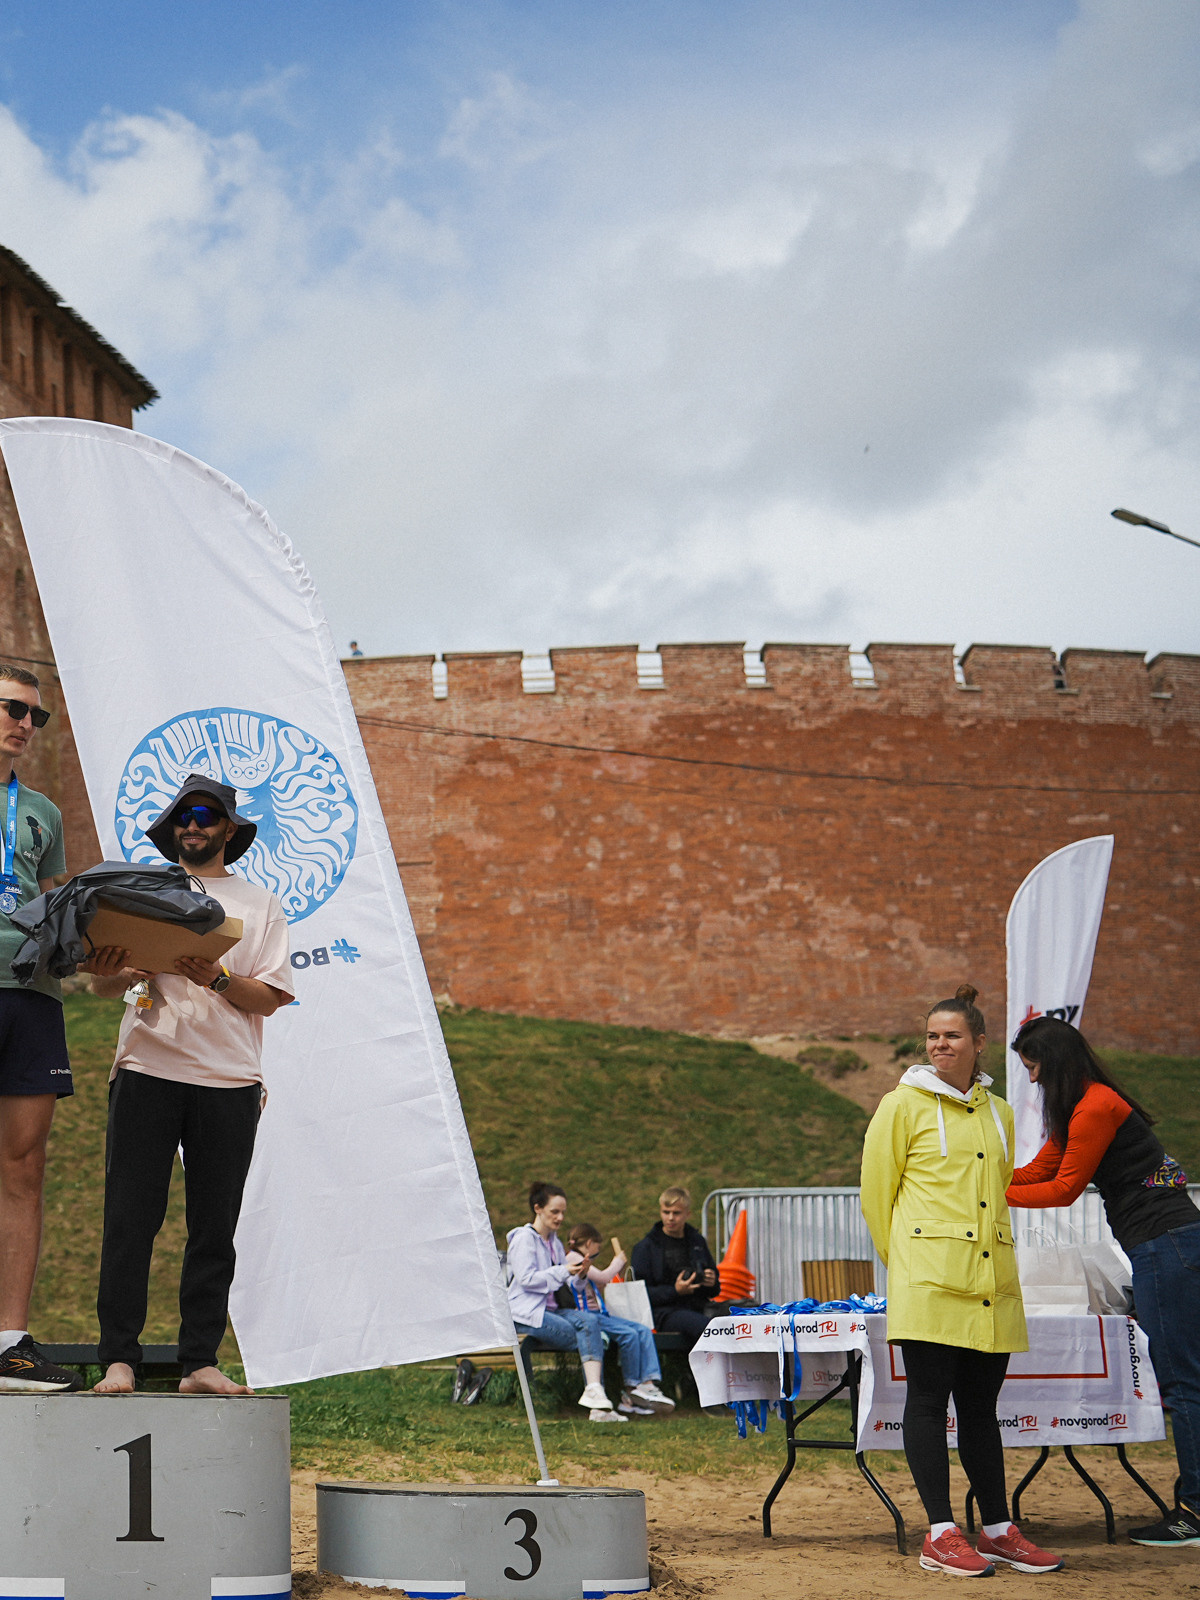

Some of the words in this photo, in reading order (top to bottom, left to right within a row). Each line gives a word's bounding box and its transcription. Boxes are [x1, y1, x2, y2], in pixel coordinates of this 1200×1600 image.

[763, 1320, 837, 1336] #vorodTRI
[1050, 1413, 1128, 1430] #novgorodTRI
[113, 1433, 165, 1542] 1
[503, 1508, 542, 1581] 3
